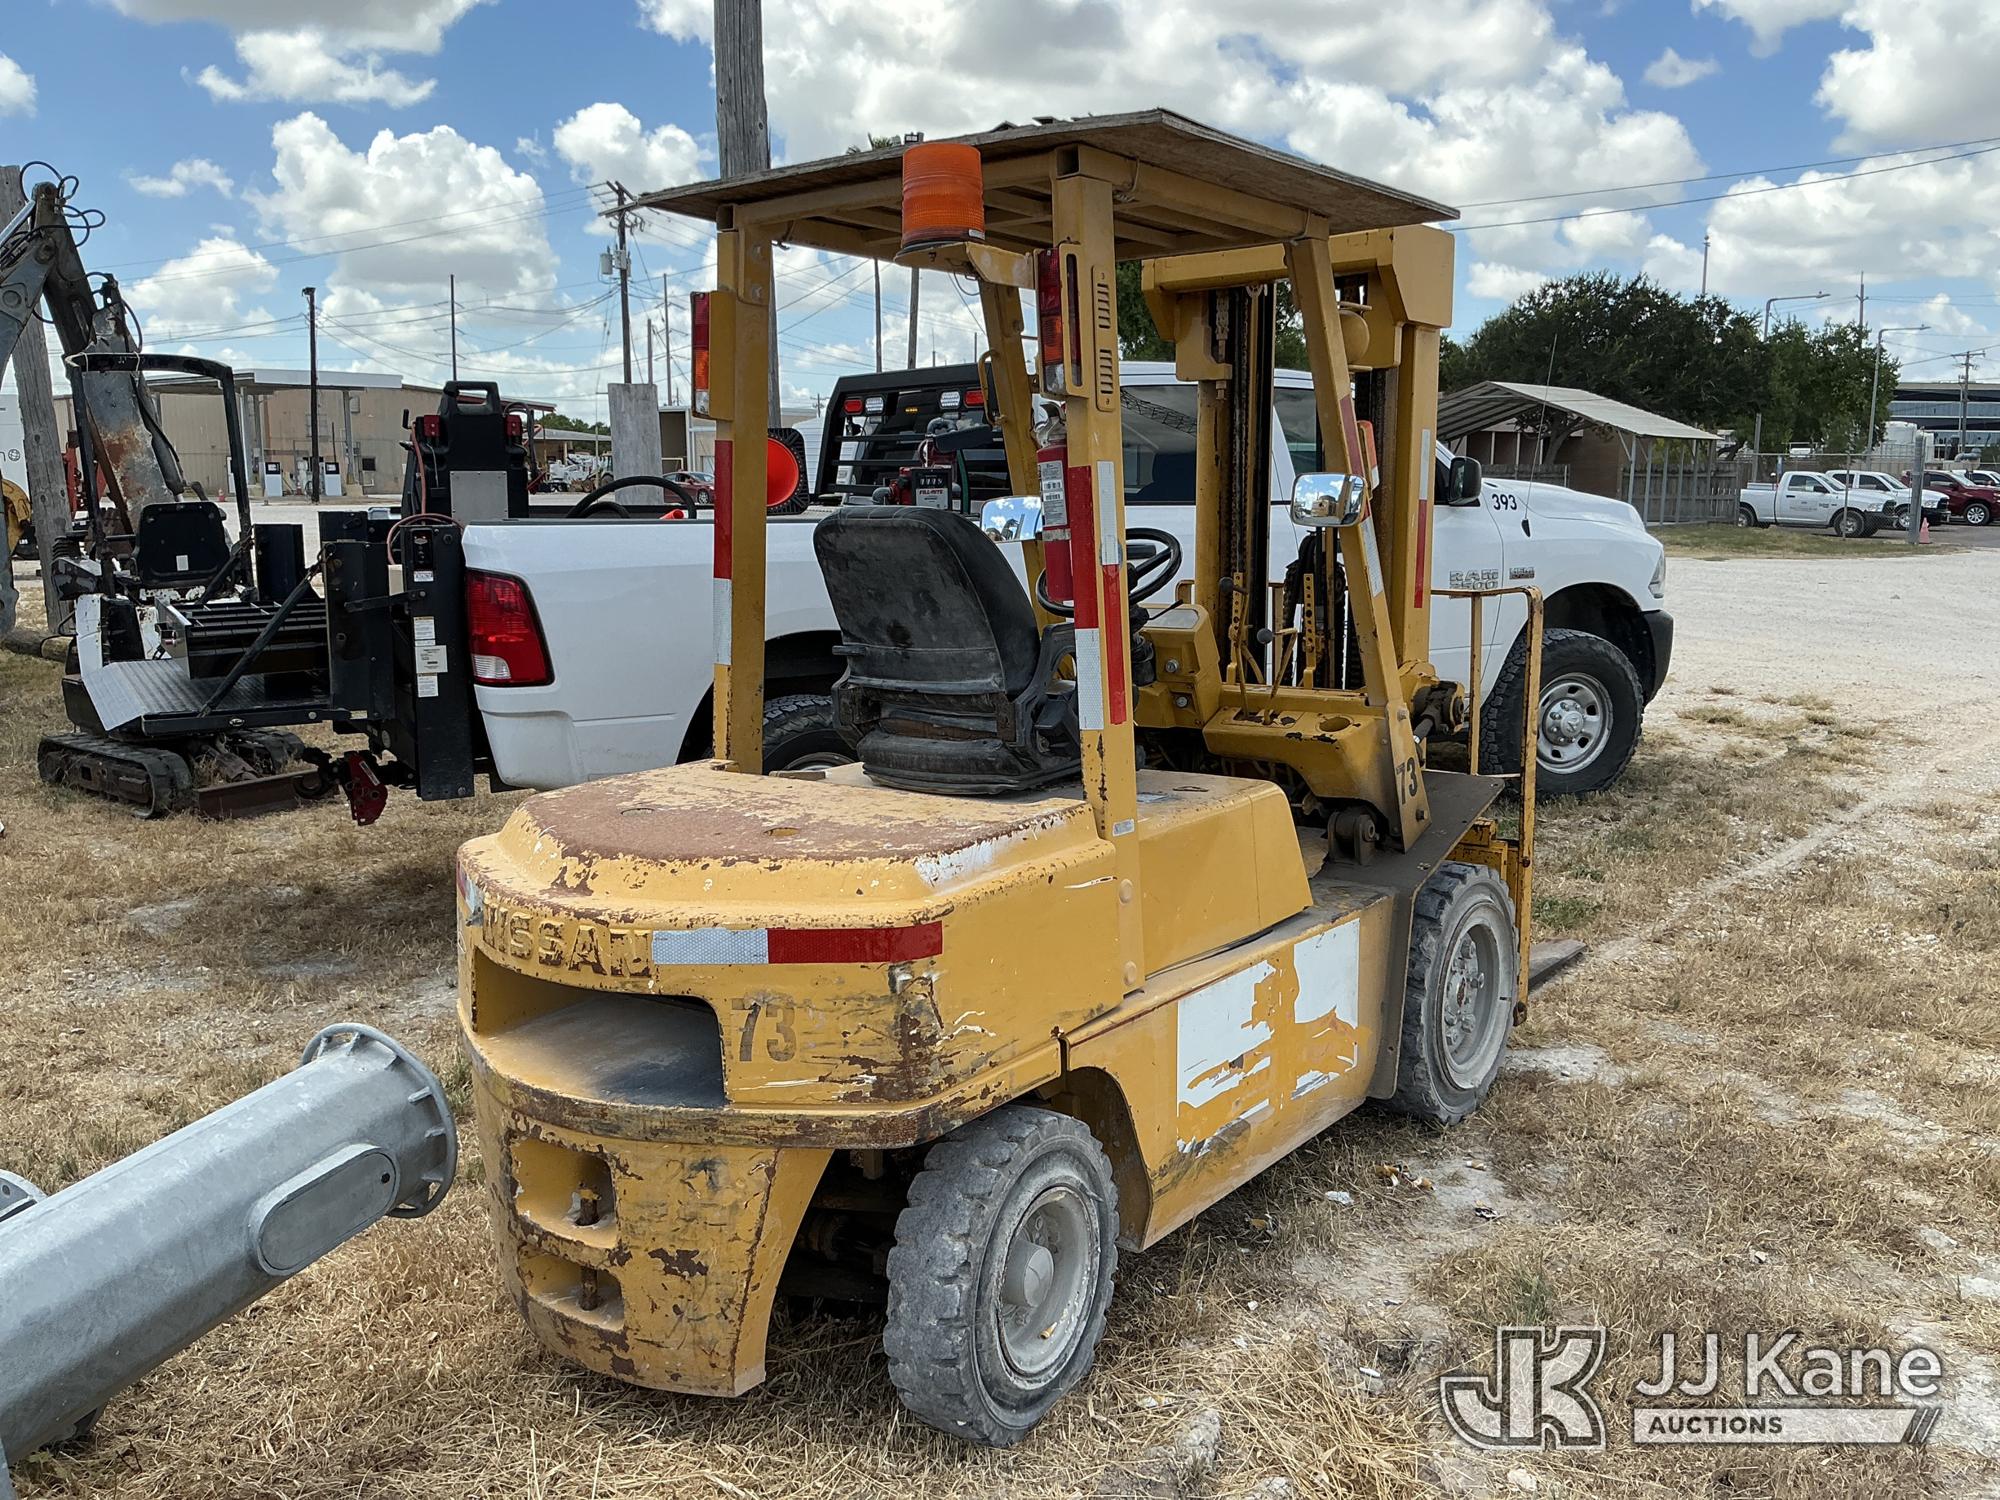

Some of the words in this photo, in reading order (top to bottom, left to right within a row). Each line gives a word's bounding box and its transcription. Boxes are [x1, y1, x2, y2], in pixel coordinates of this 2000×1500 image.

[1491, 493, 1518, 511] 393
[1449, 569, 1499, 581] RAM
[1396, 756, 1418, 805] 73
[731, 998, 797, 1062] 73
